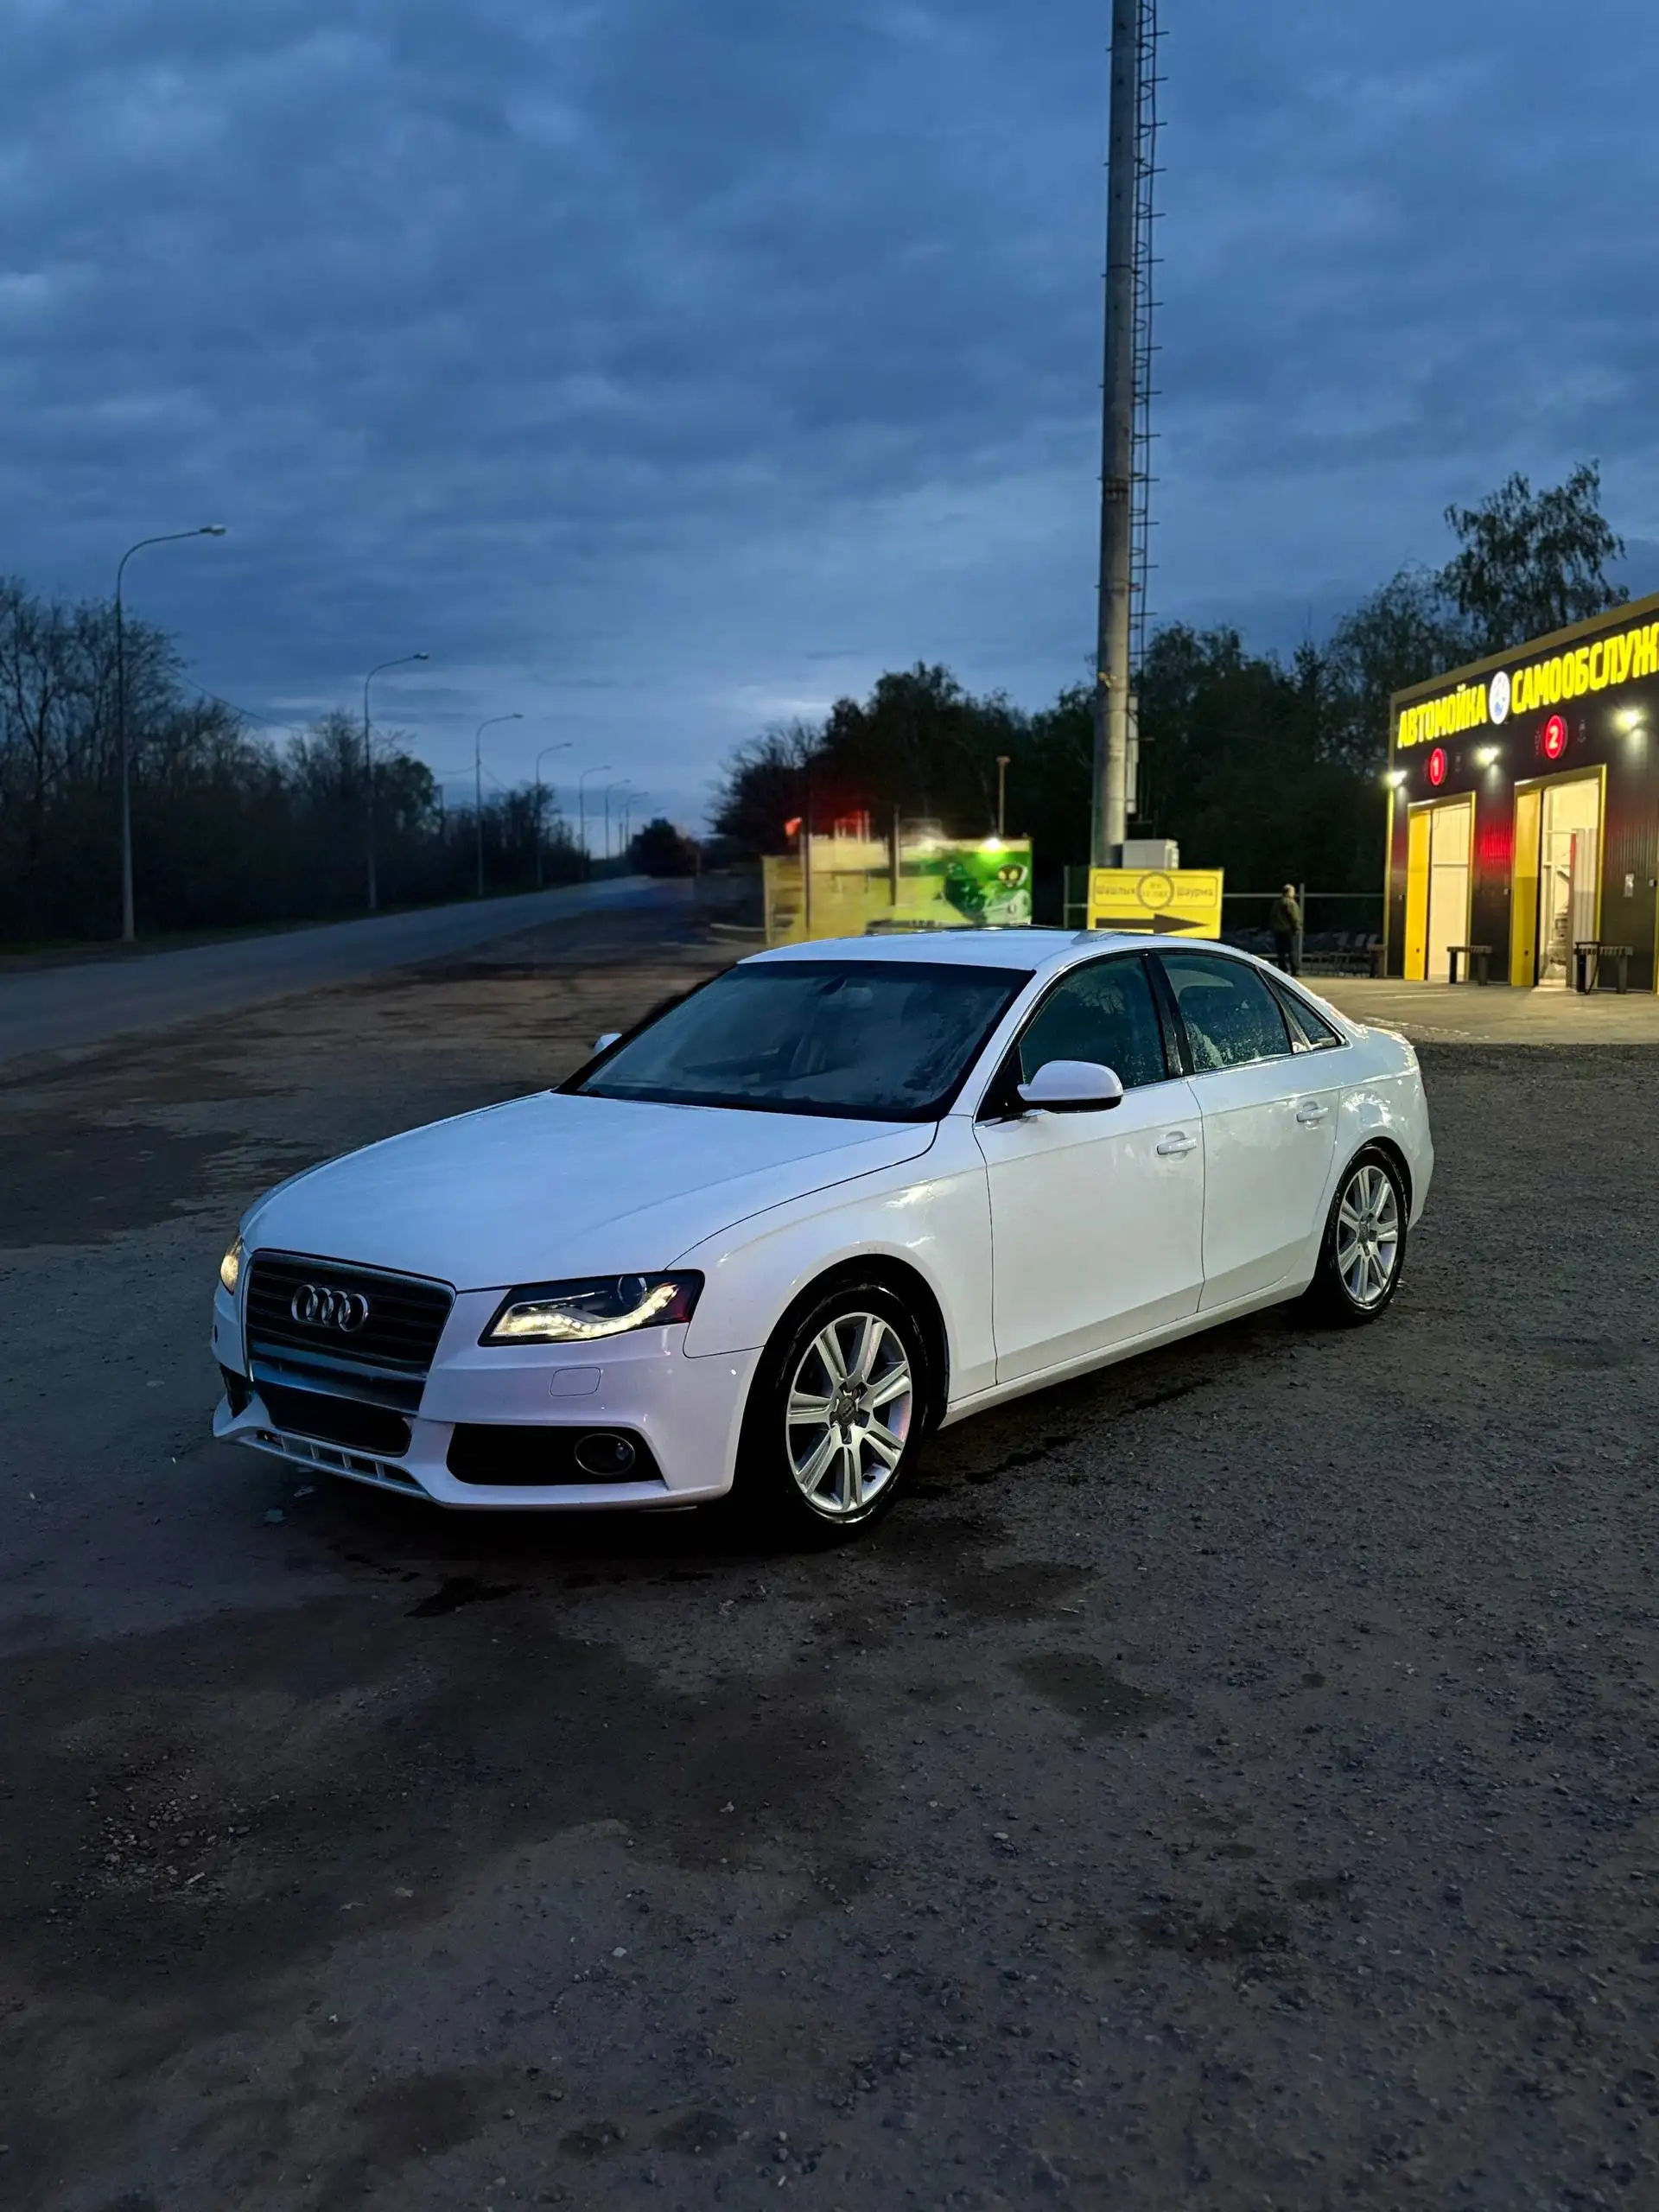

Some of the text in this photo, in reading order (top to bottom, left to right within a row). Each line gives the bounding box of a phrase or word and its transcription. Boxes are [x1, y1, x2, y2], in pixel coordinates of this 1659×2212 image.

[1397, 621, 1659, 749] АВТОМОЙКА САМООБСЛУЖ
[1548, 725, 1559, 749] 2
[1433, 756, 1440, 777] 1
